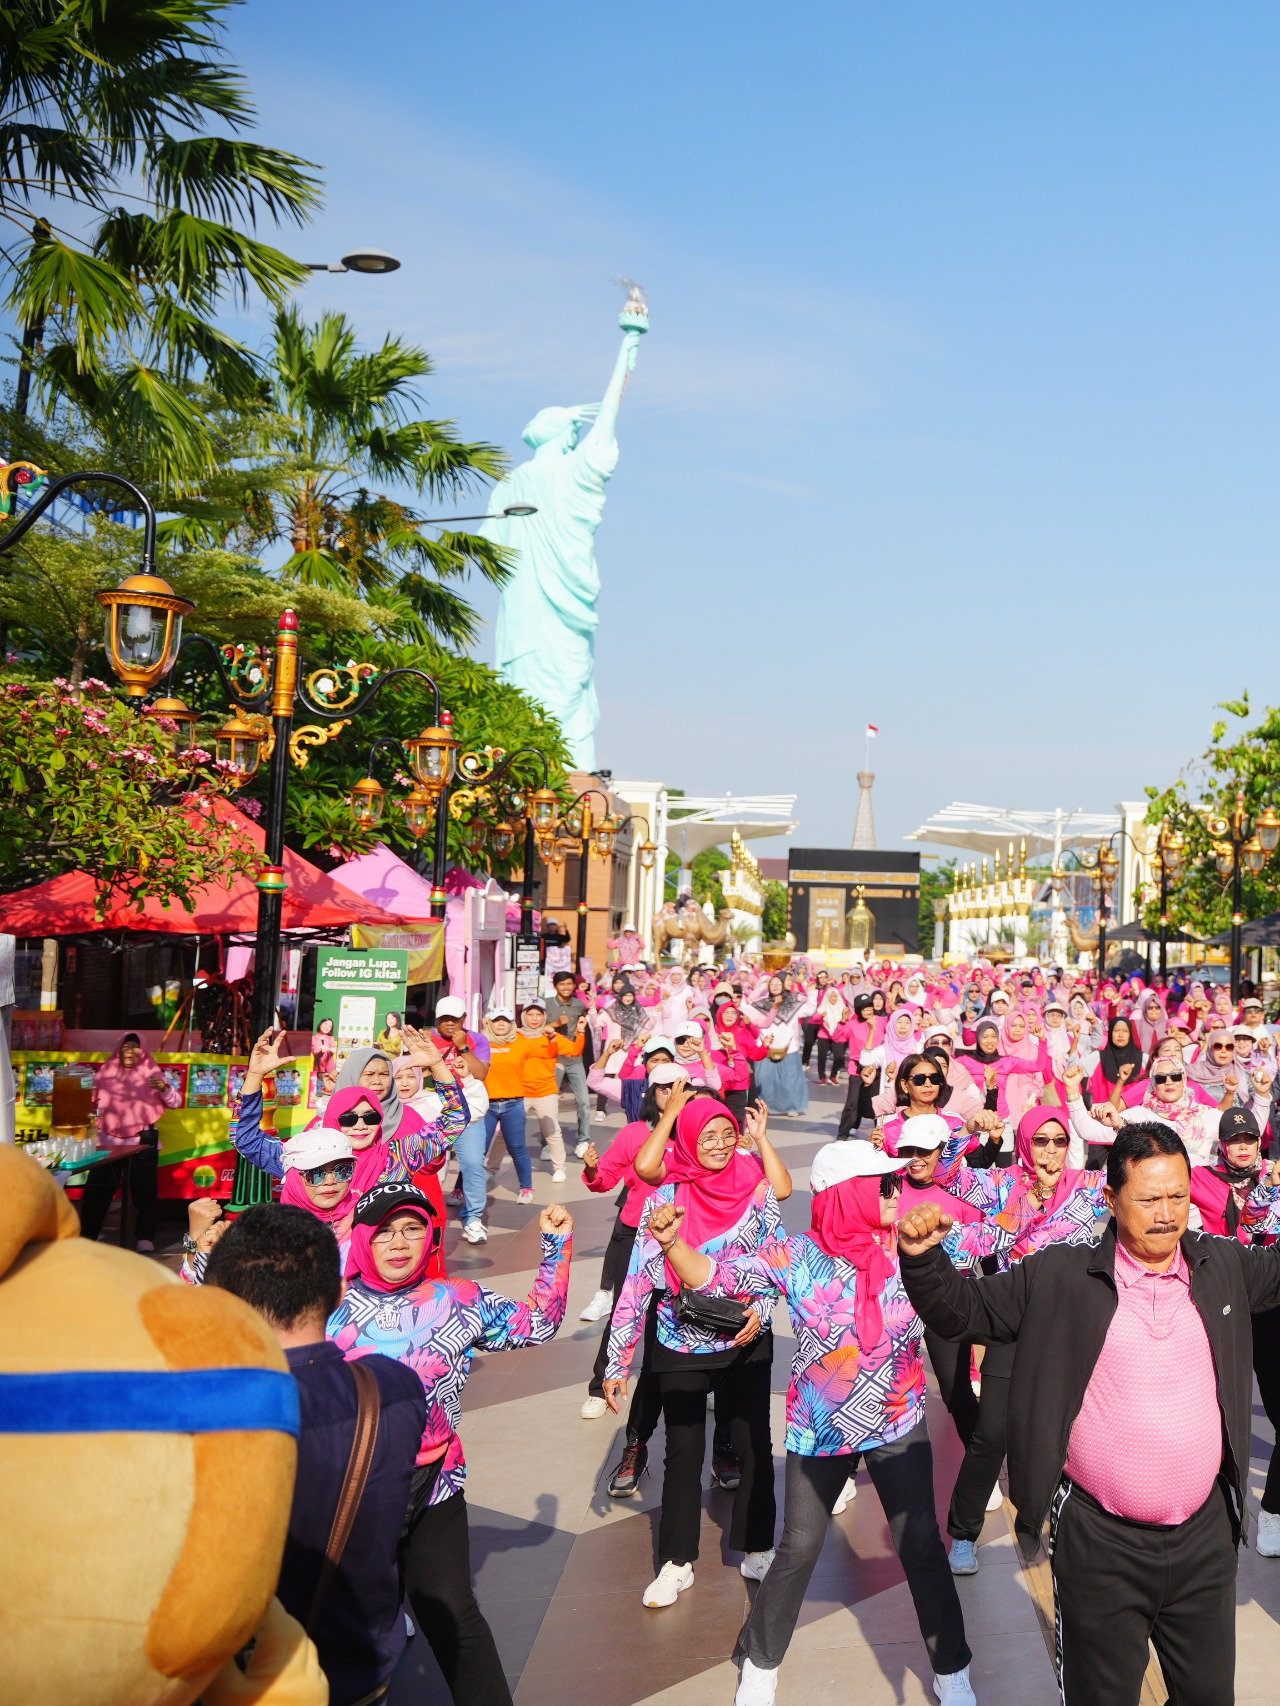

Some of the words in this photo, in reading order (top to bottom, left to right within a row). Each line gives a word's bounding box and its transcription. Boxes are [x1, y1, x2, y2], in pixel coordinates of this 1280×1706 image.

[326, 957, 366, 969] Jangan
[369, 958, 397, 969] Lupa
[322, 967, 357, 978] Follow
[359, 969, 372, 978] IG
[375, 969, 401, 980] kita!
